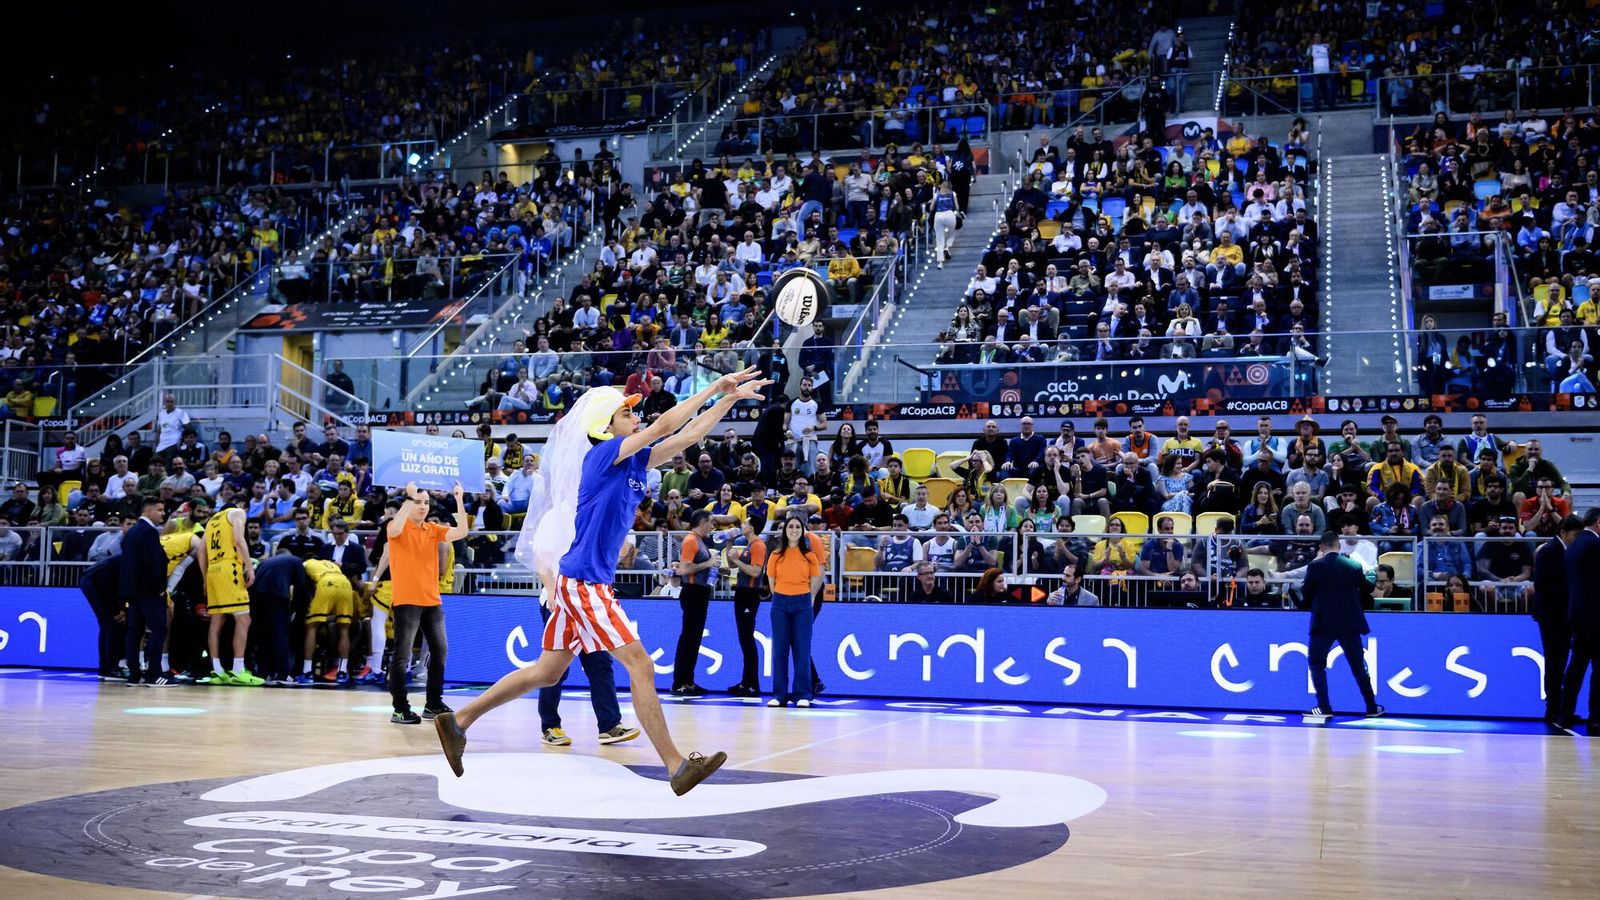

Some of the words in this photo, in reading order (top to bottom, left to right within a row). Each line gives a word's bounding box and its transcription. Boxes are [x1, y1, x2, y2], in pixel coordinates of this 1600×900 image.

[1047, 380, 1079, 393] acb
[900, 406, 956, 417] #CopaACB
[1227, 401, 1288, 412] #CopaACB
[38, 419, 78, 428] #CopaAB
[401, 452, 417, 462] UN
[419, 452, 443, 465] AÑO
[444, 456, 459, 466] DE
[401, 462, 421, 473] LUZ
[422, 465, 460, 477] GRATIS
[217, 815, 368, 831] Gran
[376, 824, 636, 848] Canaria
[656, 842, 737, 855] '25
[192, 838, 533, 873] Copa
[144, 857, 286, 873] del
[240, 866, 518, 900] Rey
